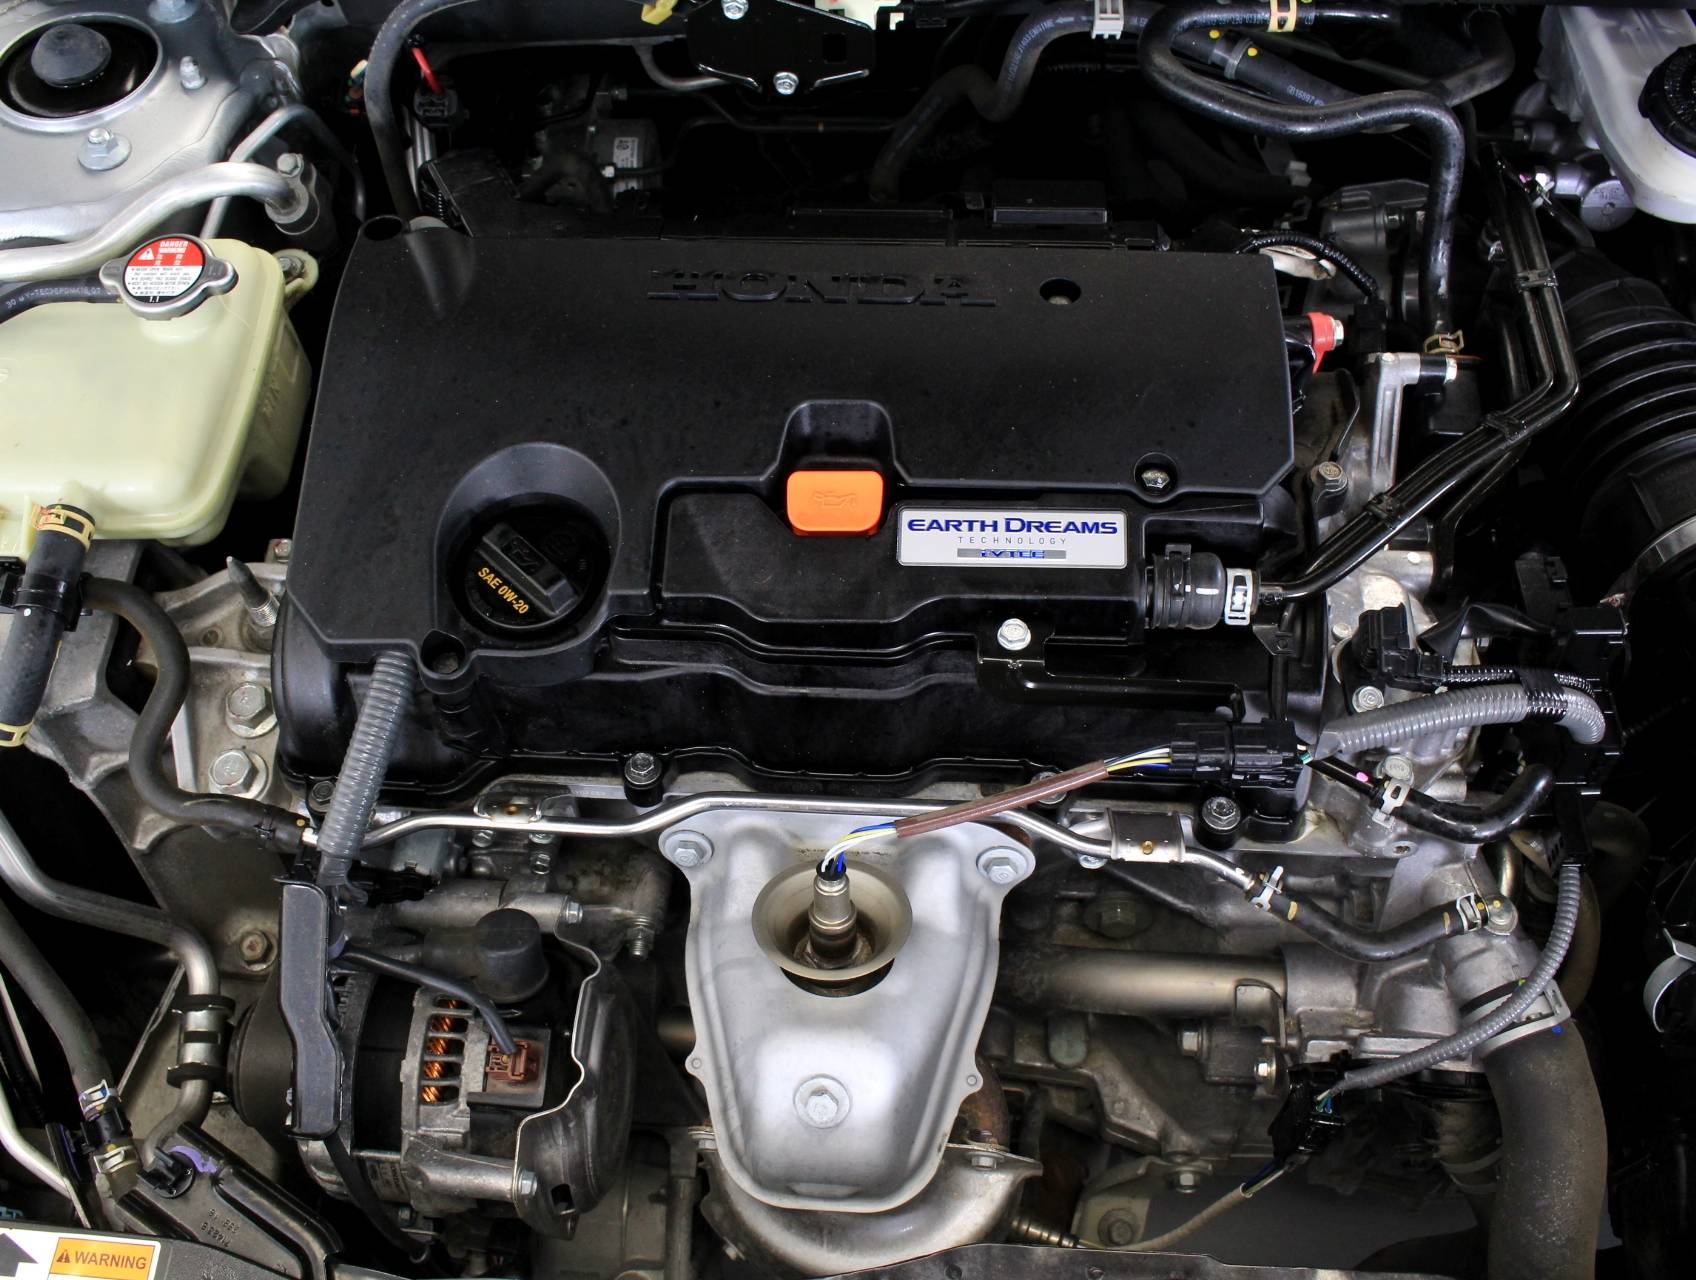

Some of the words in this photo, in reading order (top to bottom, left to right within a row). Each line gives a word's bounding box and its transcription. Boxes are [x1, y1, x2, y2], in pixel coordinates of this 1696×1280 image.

[648, 270, 996, 307] HONDA
[907, 519, 998, 533] EARTH
[1005, 518, 1118, 534] DREAMS
[958, 537, 1067, 545] TECHNOLOGY
[478, 567, 503, 590] SAE
[497, 585, 530, 614] 0W-20
[74, 1250, 148, 1271] WARNING
